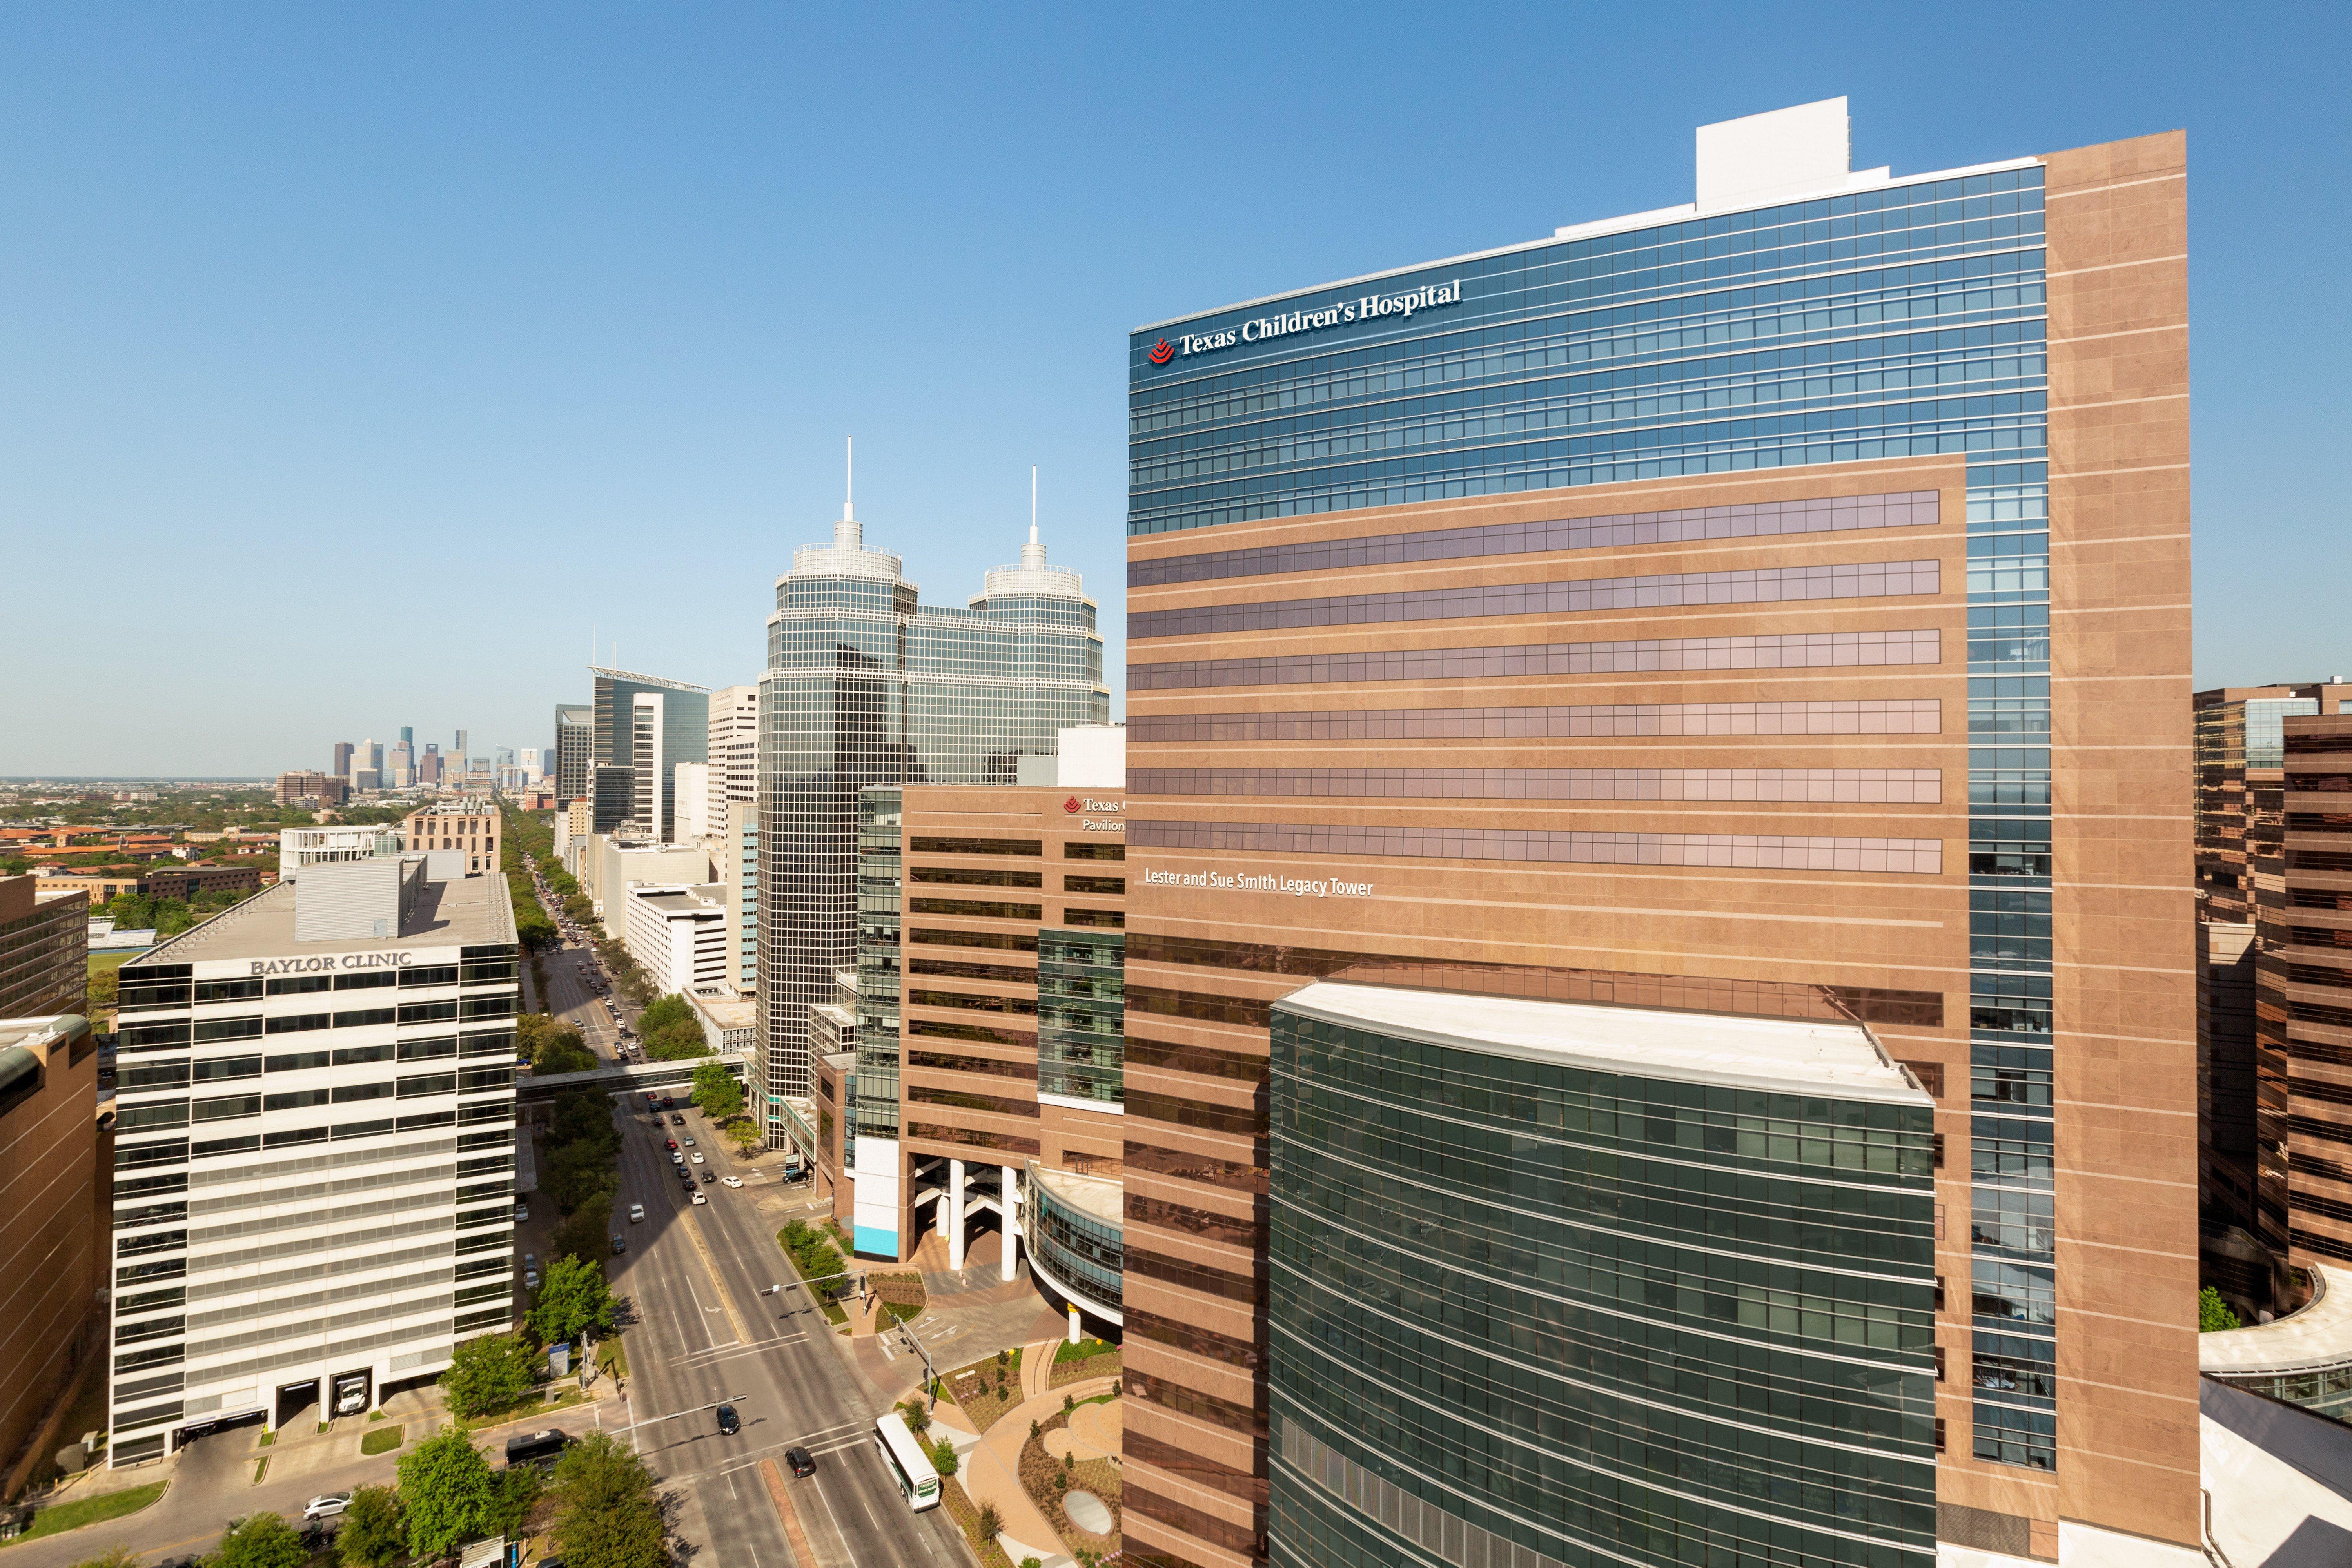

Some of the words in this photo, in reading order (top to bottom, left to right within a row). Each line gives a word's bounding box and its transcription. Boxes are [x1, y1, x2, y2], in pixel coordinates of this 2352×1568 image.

[1179, 330, 1236, 355] Texas
[1359, 279, 1461, 319] Hospital
[1083, 798, 1119, 811] Texas
[1083, 819, 1125, 831] Pavilion
[1145, 867, 1181, 885] Lester
[1183, 870, 1207, 887] and
[1210, 871, 1234, 888] Sue
[1236, 873, 1276, 891] Smith
[1280, 875, 1328, 898] Legacy
[1330, 877, 1374, 896] Tower
[250, 957, 336, 975] BAYLOR
[342, 952, 412, 969] CLINIC
